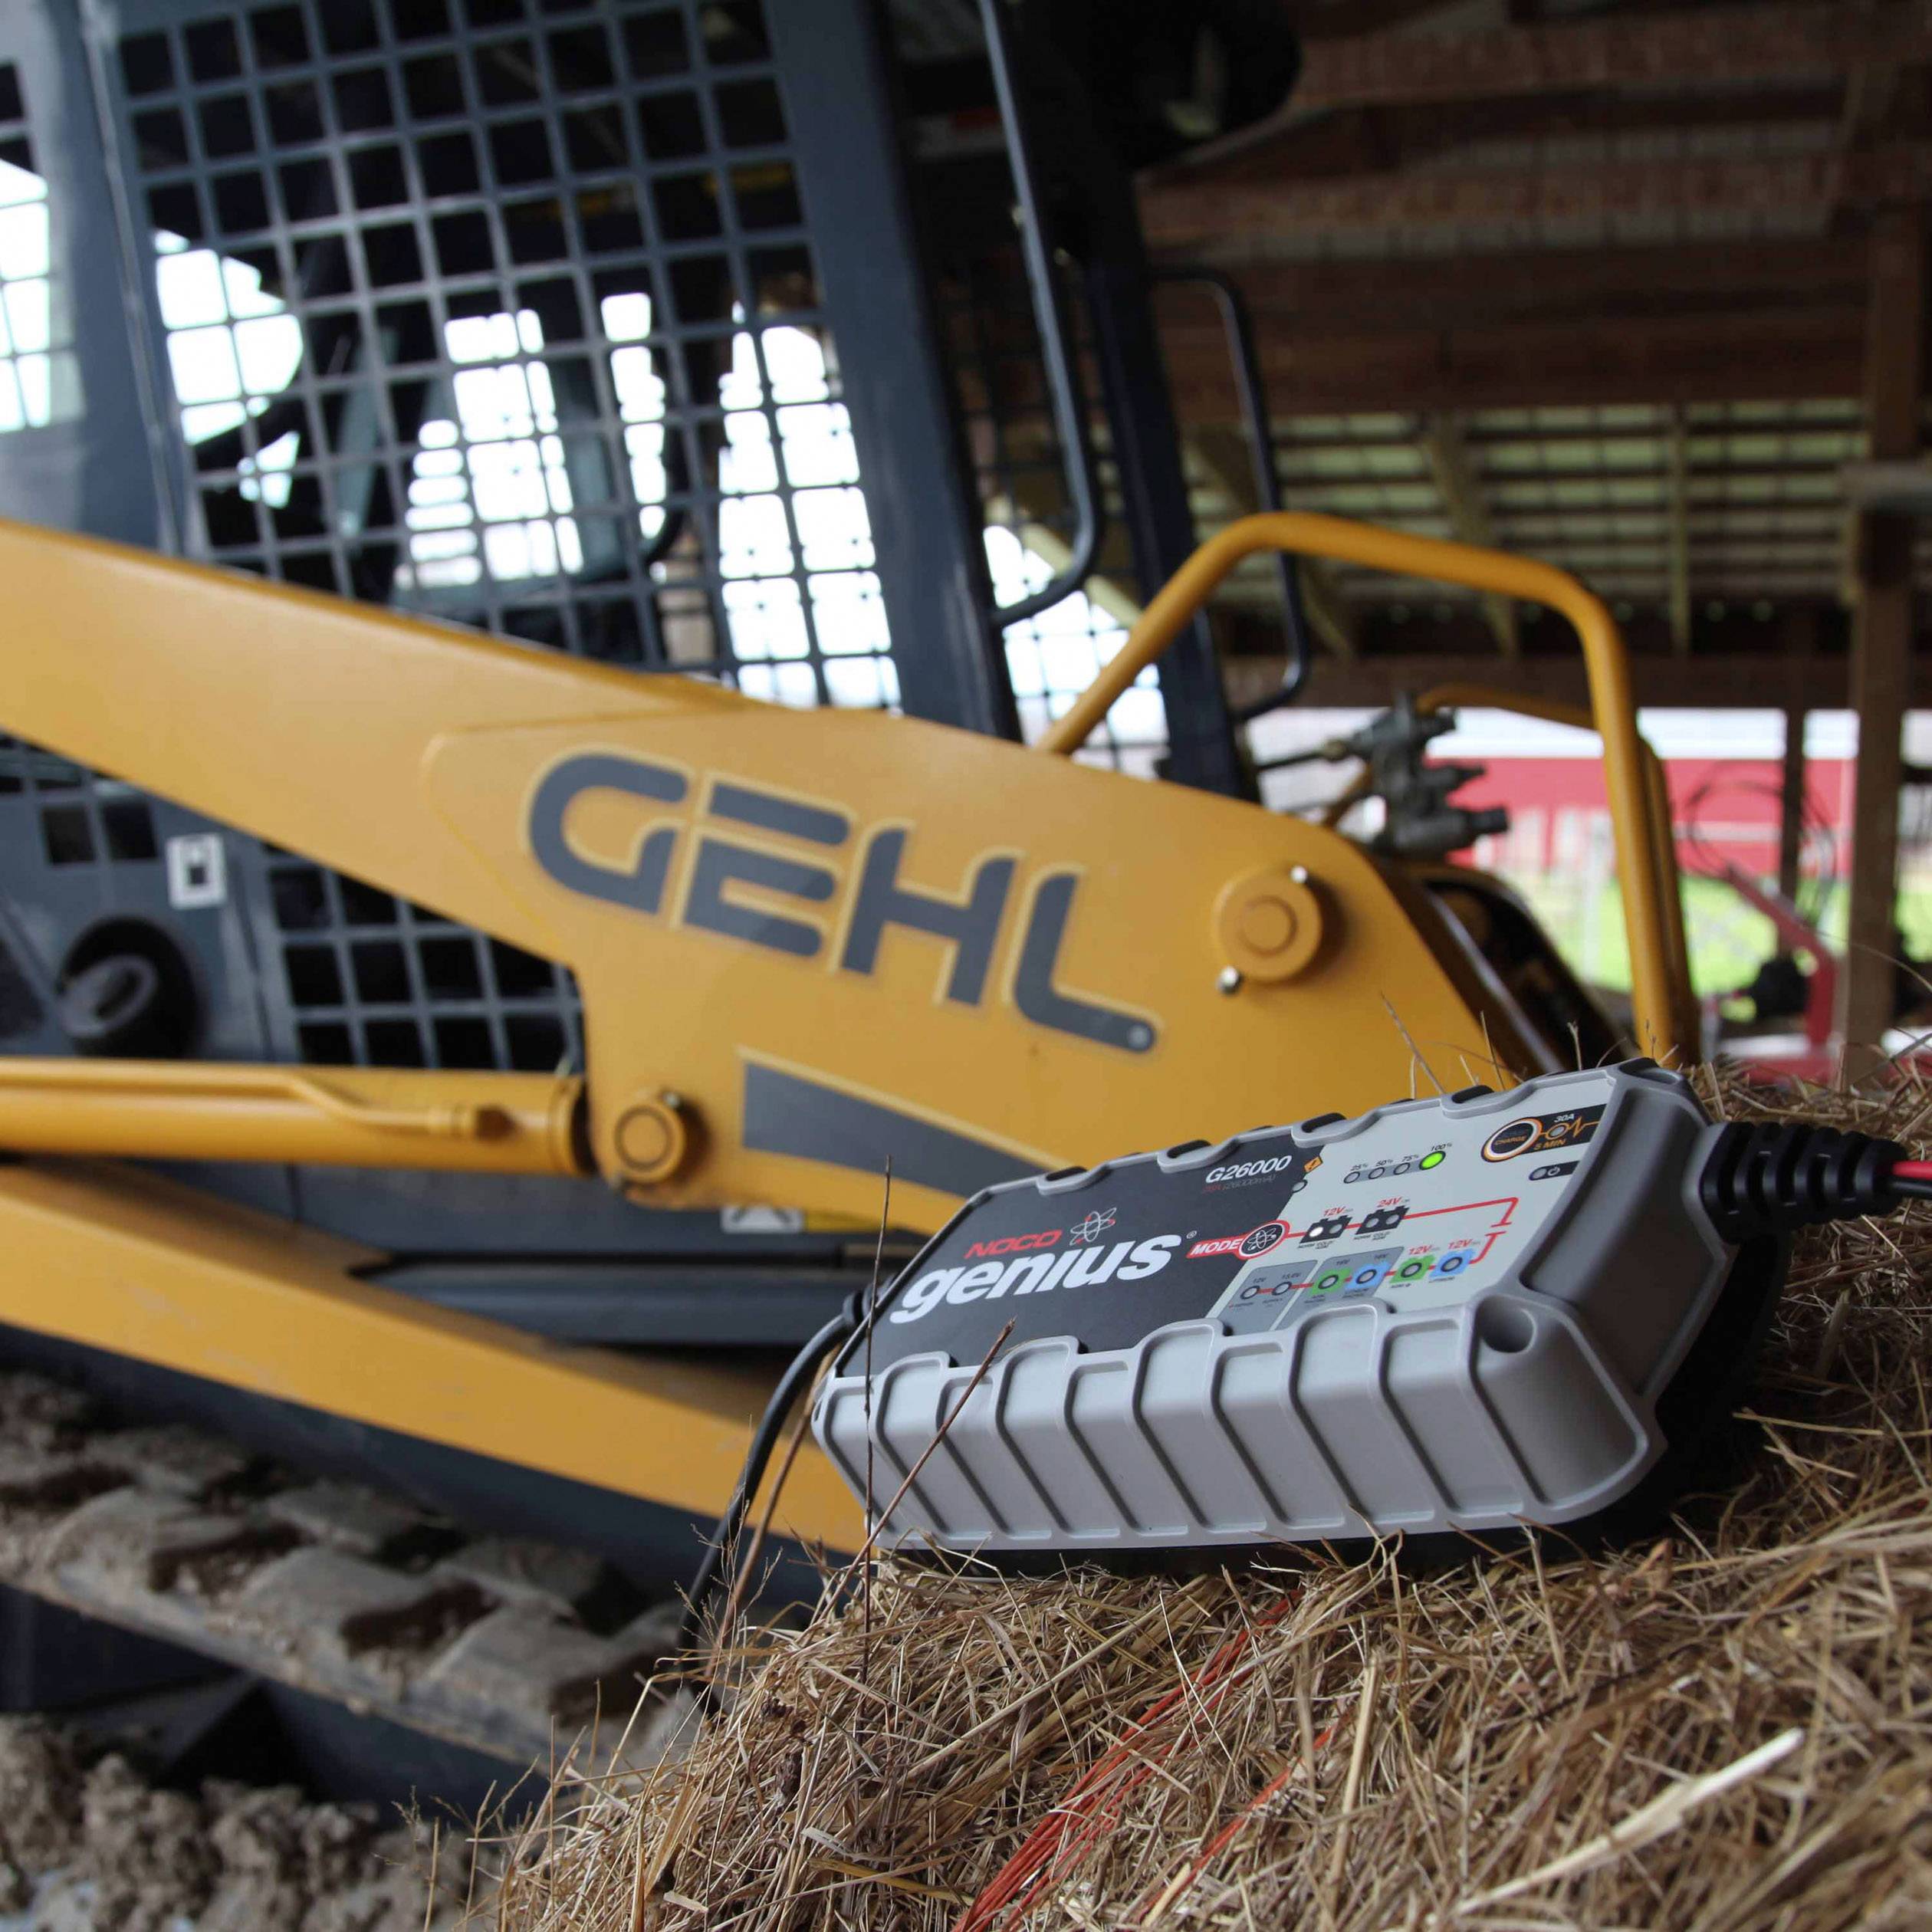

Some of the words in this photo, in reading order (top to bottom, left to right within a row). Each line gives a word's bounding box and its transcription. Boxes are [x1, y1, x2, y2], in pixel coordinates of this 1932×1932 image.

[527, 751, 1158, 1054] GEHL
[1205, 1155, 1293, 1184] G26000
[1324, 1206, 1346, 1217] 12V
[1376, 1196, 1402, 1208] 24V
[963, 1229, 1063, 1259] NOCO
[1190, 1237, 1243, 1257] MODE
[1408, 1244, 1433, 1256] 12V
[1447, 1238, 1473, 1250] 12V
[889, 1234, 1182, 1324] genius
